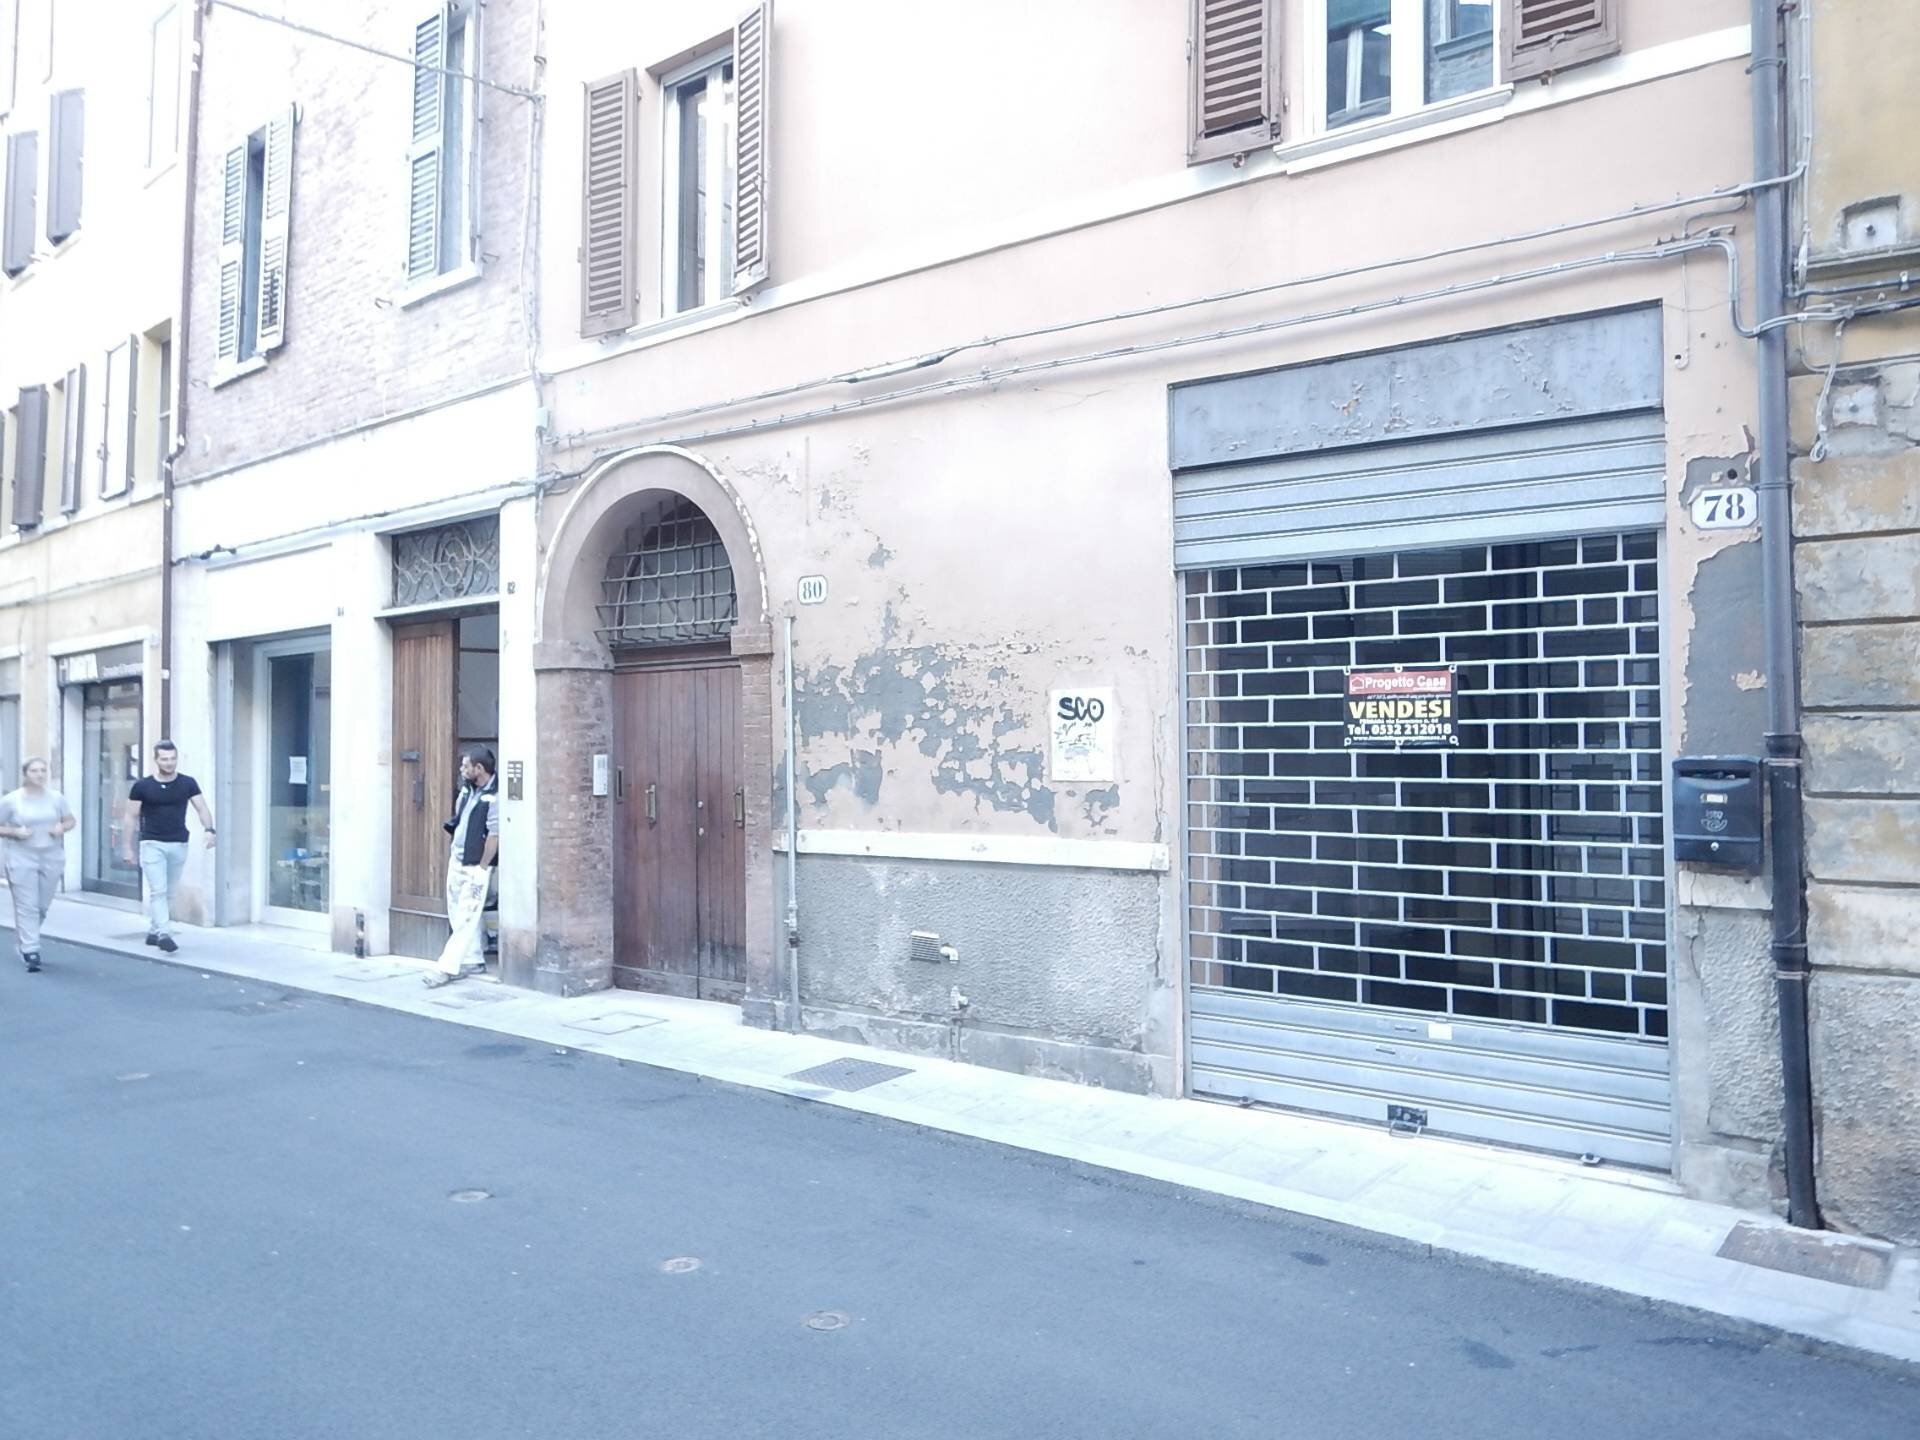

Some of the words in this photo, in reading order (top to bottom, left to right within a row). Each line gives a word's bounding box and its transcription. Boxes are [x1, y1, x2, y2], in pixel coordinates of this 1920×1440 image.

[1703, 493, 1746, 522] 78
[802, 580, 822, 600] 80
[1364, 675, 1414, 690] Progetto
[1348, 699, 1451, 719] VENDESI
[1347, 724, 1370, 735] Tel.
[1371, 723, 1402, 735] 0532
[1404, 722, 1452, 735] 212018
